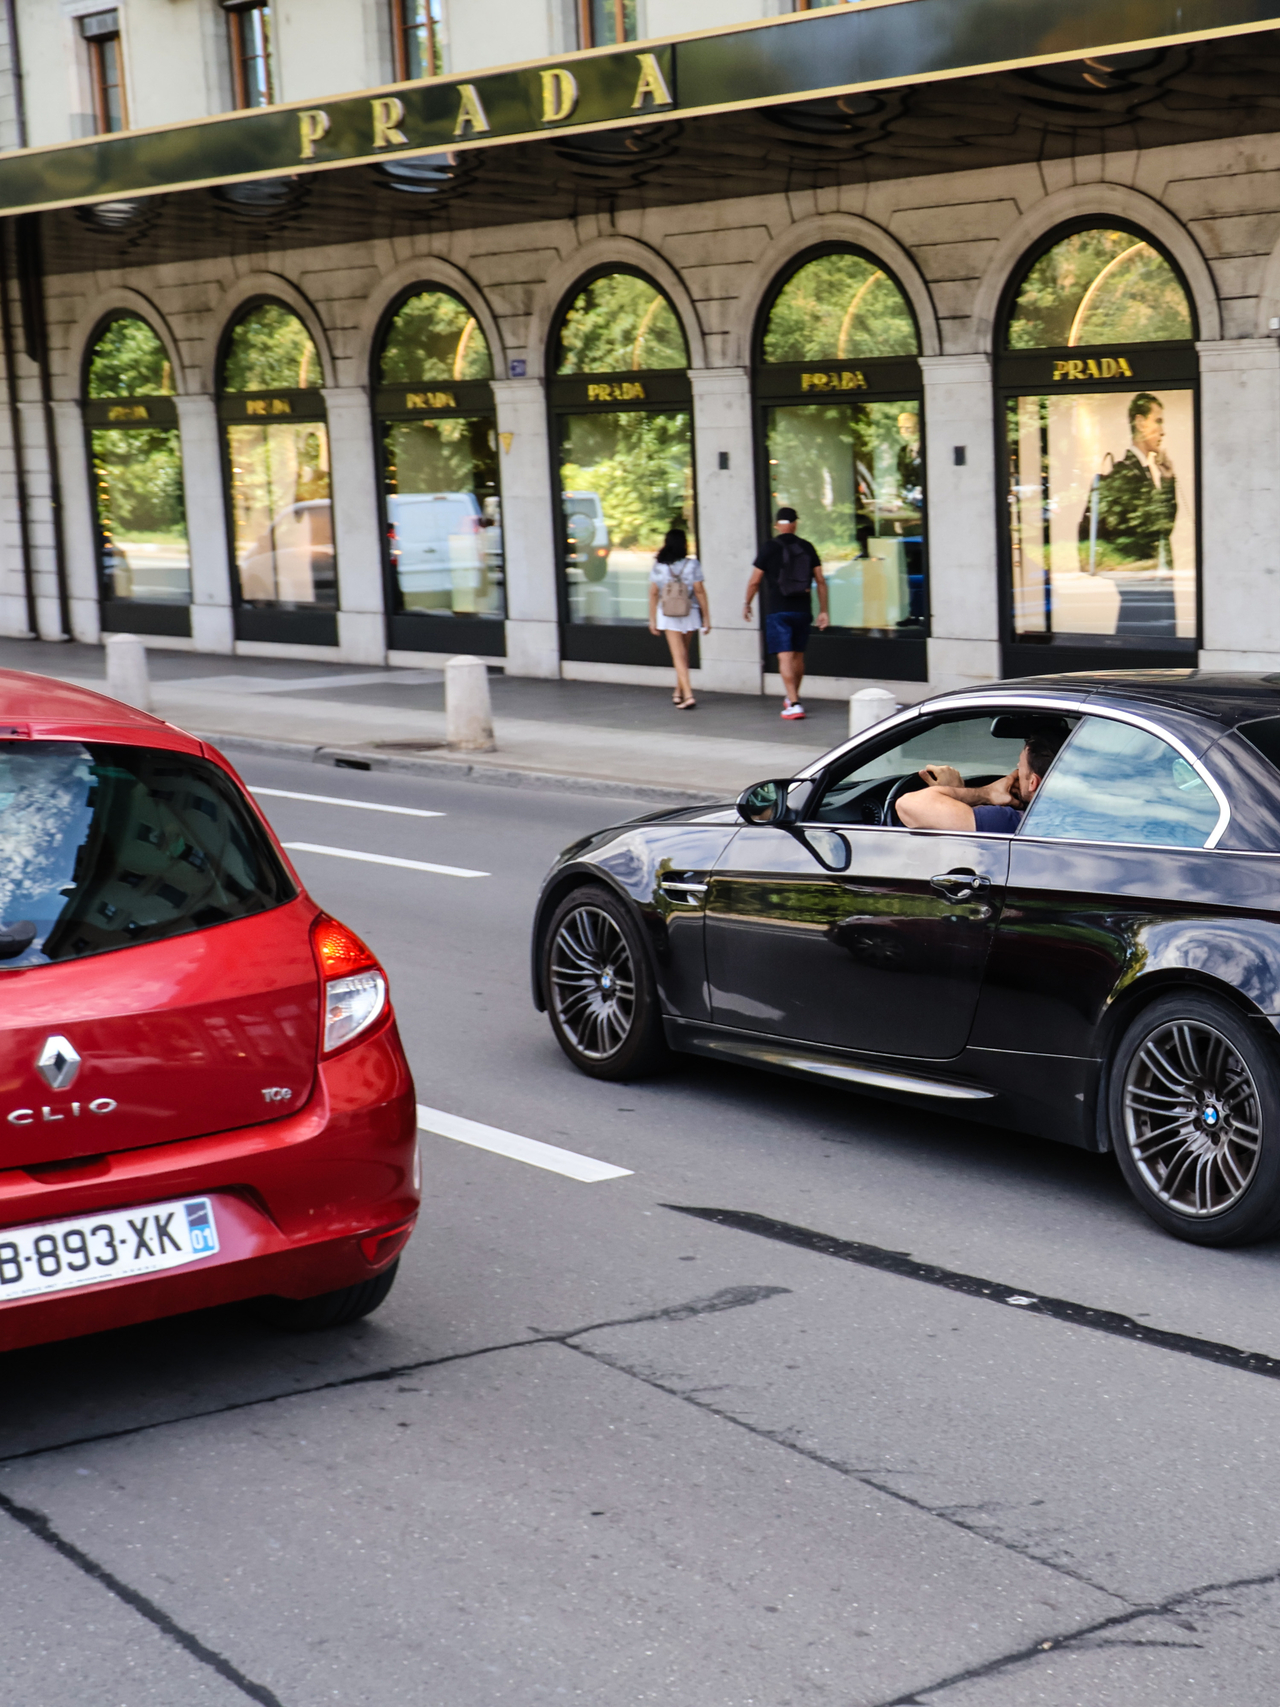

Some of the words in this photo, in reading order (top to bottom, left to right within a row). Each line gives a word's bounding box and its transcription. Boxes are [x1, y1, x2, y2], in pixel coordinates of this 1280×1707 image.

[297, 53, 673, 159] PRADA
[1052, 356, 1134, 381] PRADA
[587, 381, 646, 401] PRADA
[800, 370, 869, 392] PRADA
[7, 1097, 118, 1125] CLIO
[190, 1227, 214, 1250] 01
